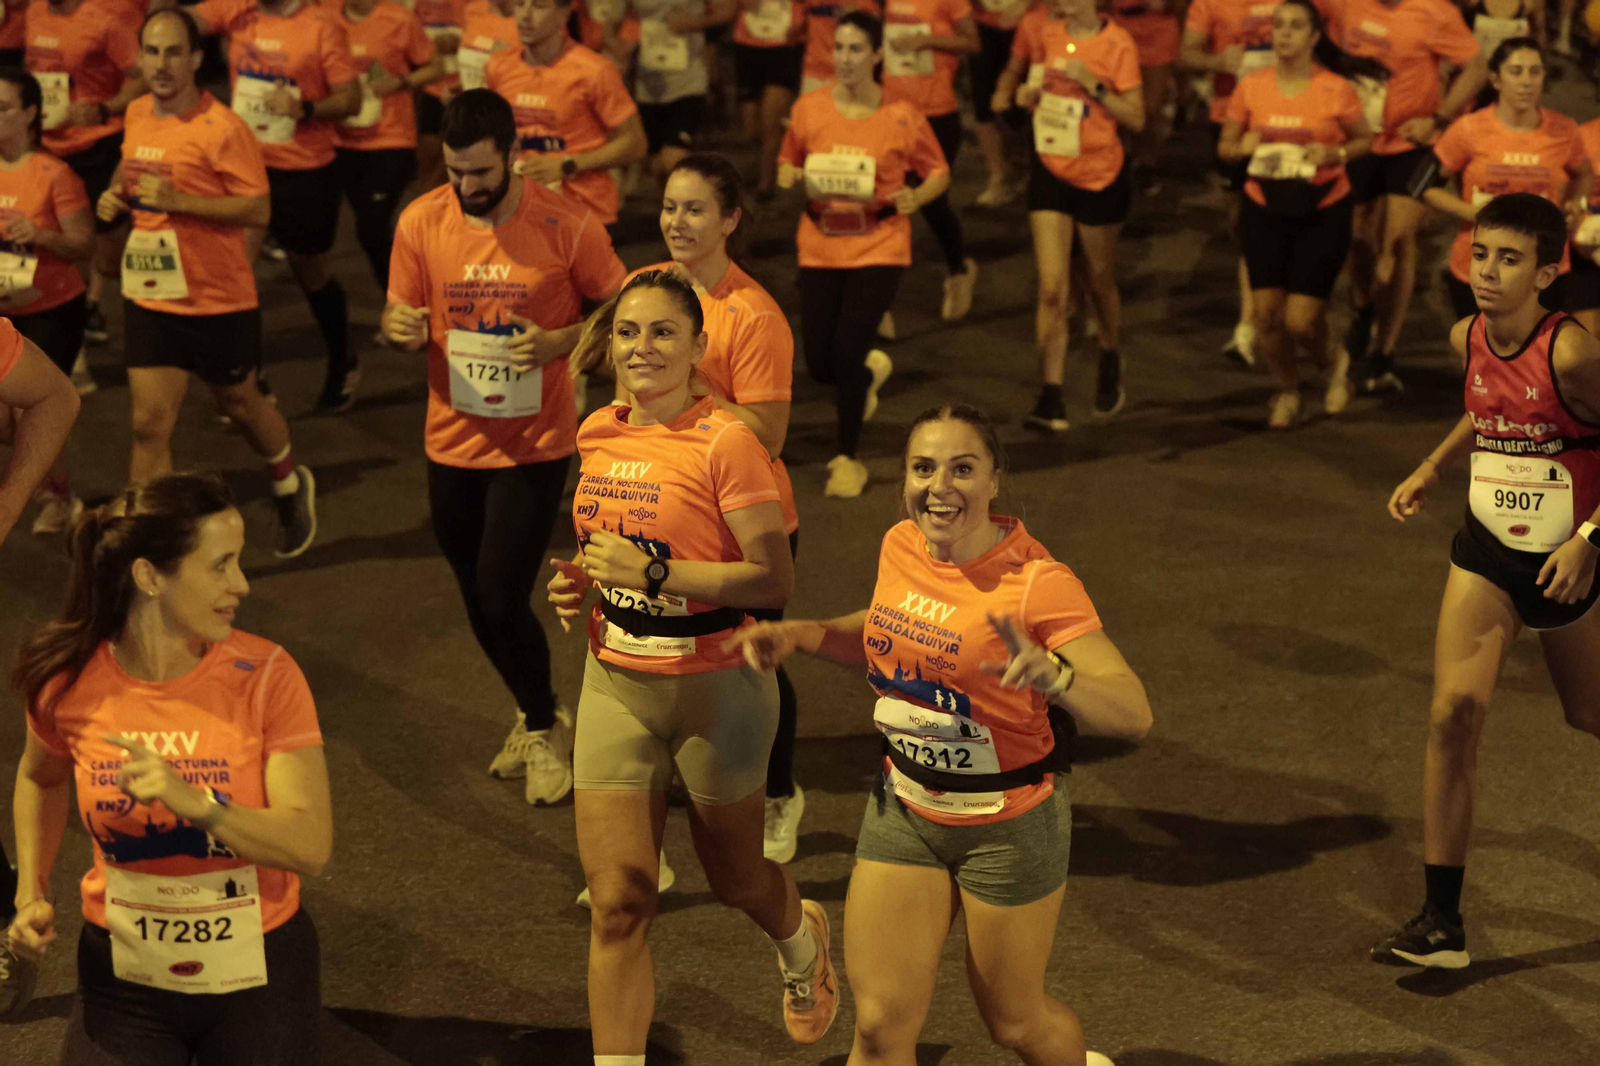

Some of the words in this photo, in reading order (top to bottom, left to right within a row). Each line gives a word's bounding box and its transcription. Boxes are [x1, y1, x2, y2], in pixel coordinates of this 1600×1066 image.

[463, 264, 512, 281] XXXV
[449, 289, 528, 298] GUADALQUIVIR
[603, 461, 653, 479] XXXV
[583, 475, 614, 486] CARRERA
[616, 480, 661, 492] NOCTURNA
[582, 484, 659, 504] GUADALQUIVIR
[1494, 489, 1545, 511] 9907
[897, 590, 957, 624] XXXV
[874, 602, 910, 625] CARRERA
[912, 619, 963, 643] NOCTURNA
[873, 614, 960, 656] GUADALQUIVIR
[896, 738, 973, 769] 17312
[98, 771, 231, 786] GUUIVIR
[963, 800, 998, 808] Cruzcampo
[135, 915, 233, 944] 17282
